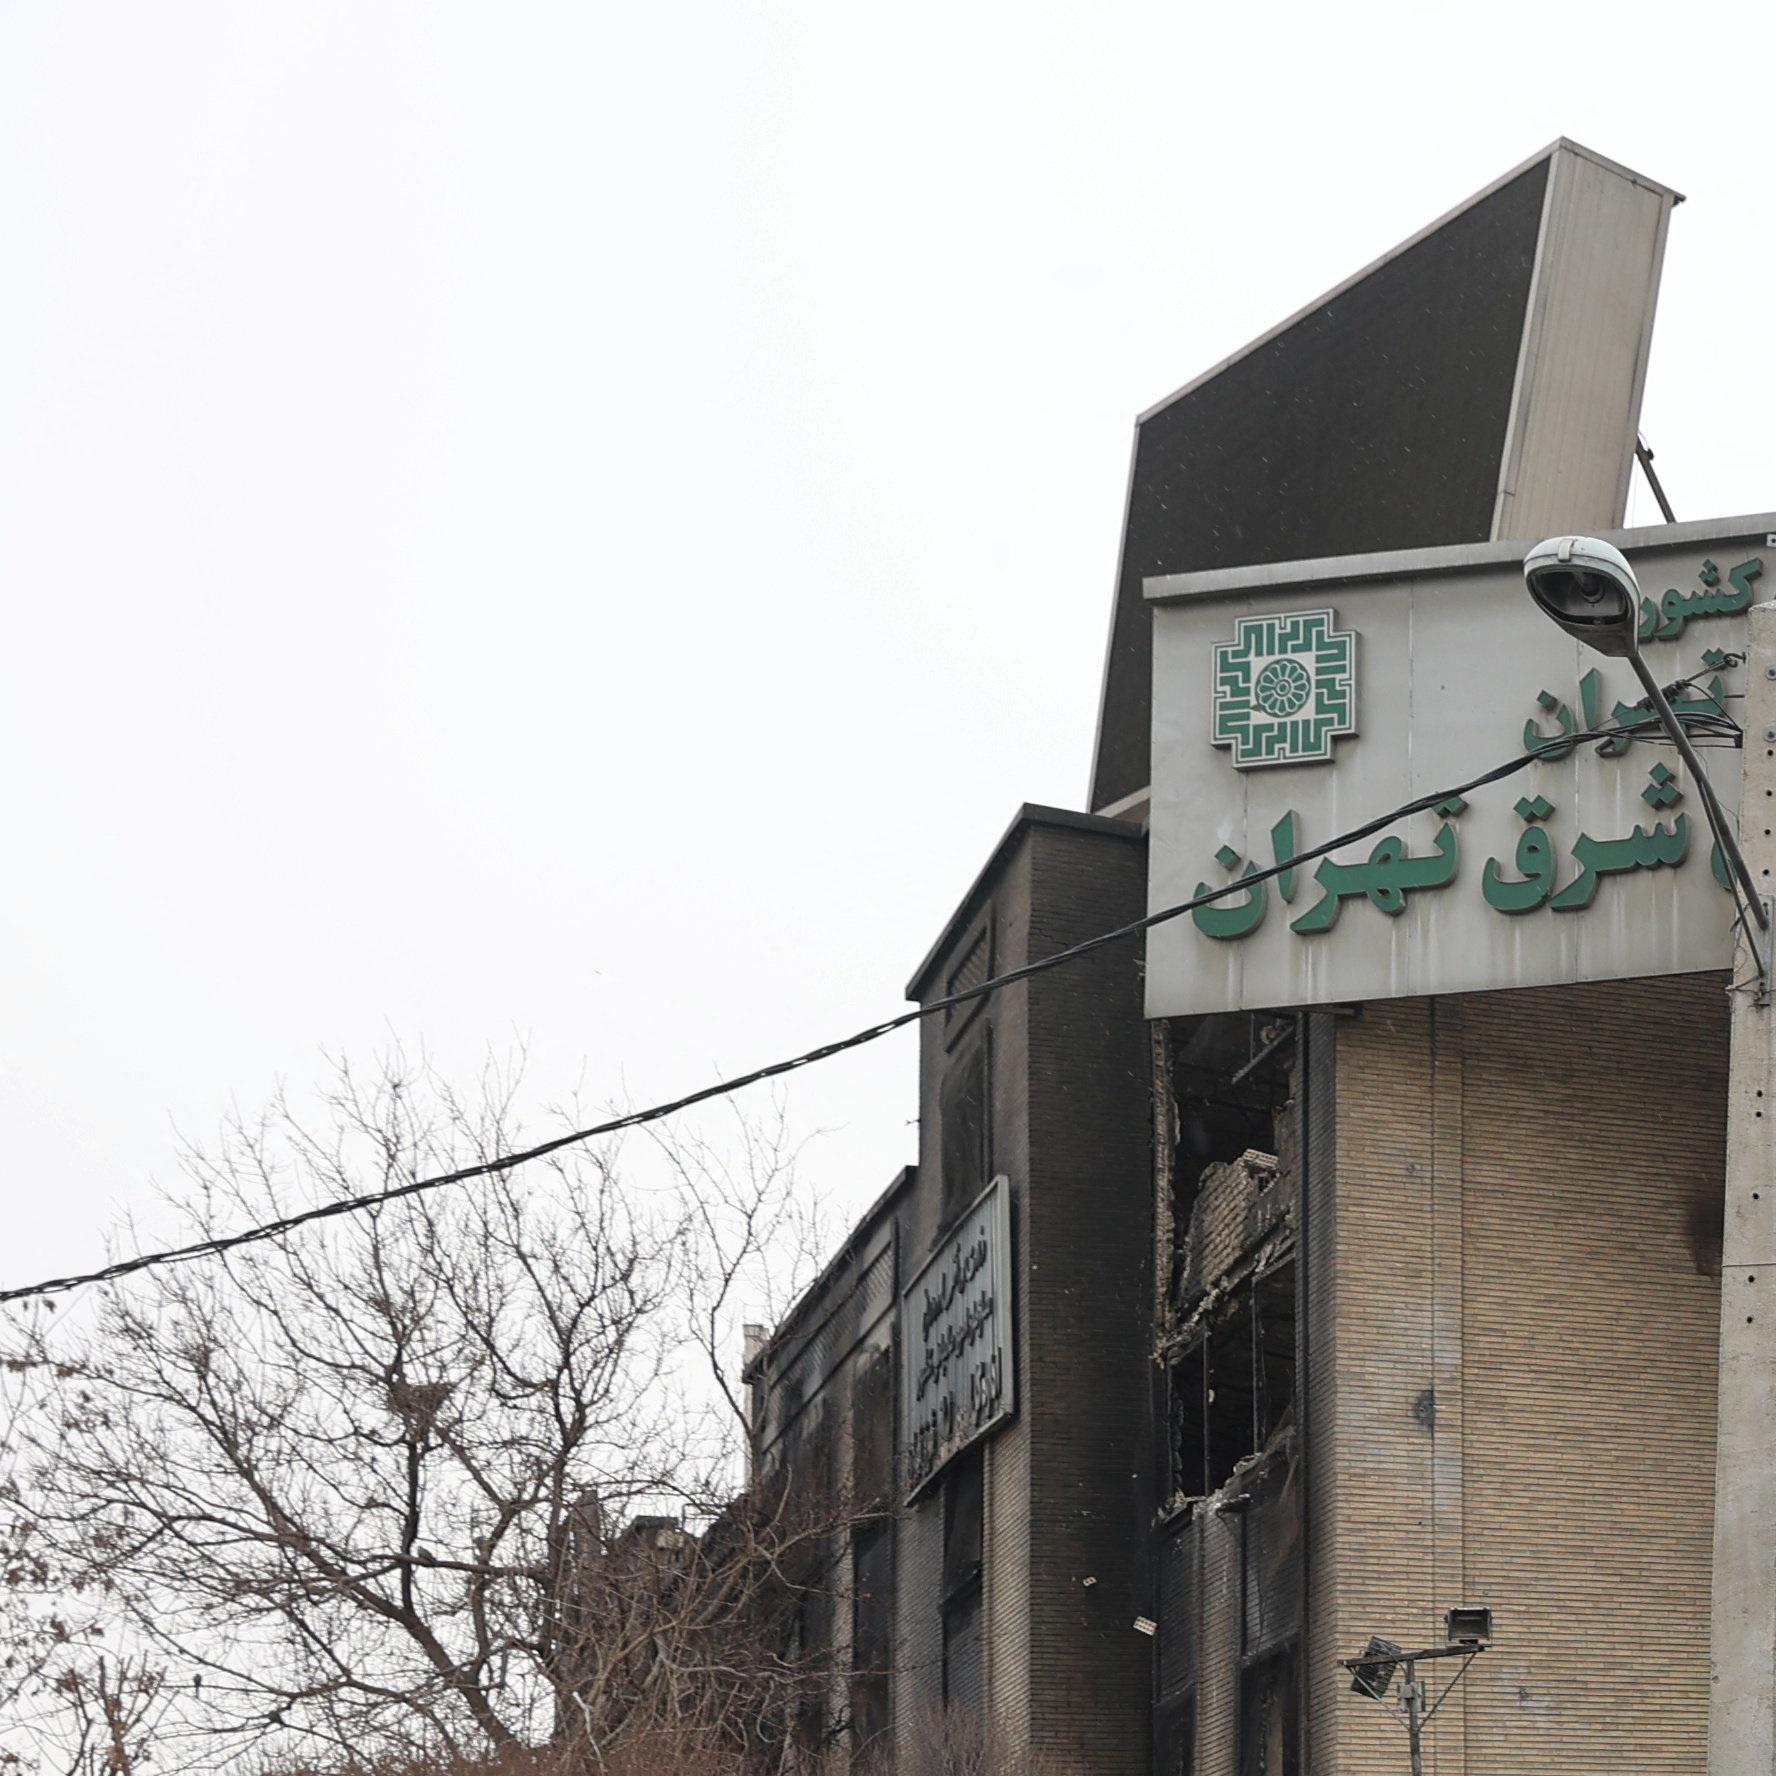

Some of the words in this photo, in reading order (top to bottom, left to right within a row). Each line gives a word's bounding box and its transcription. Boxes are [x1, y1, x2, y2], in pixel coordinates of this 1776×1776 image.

[1638, 558, 1764, 644] کشور
[1191, 793, 1470, 941] تهران
[1482, 761, 1694, 915] شرق
